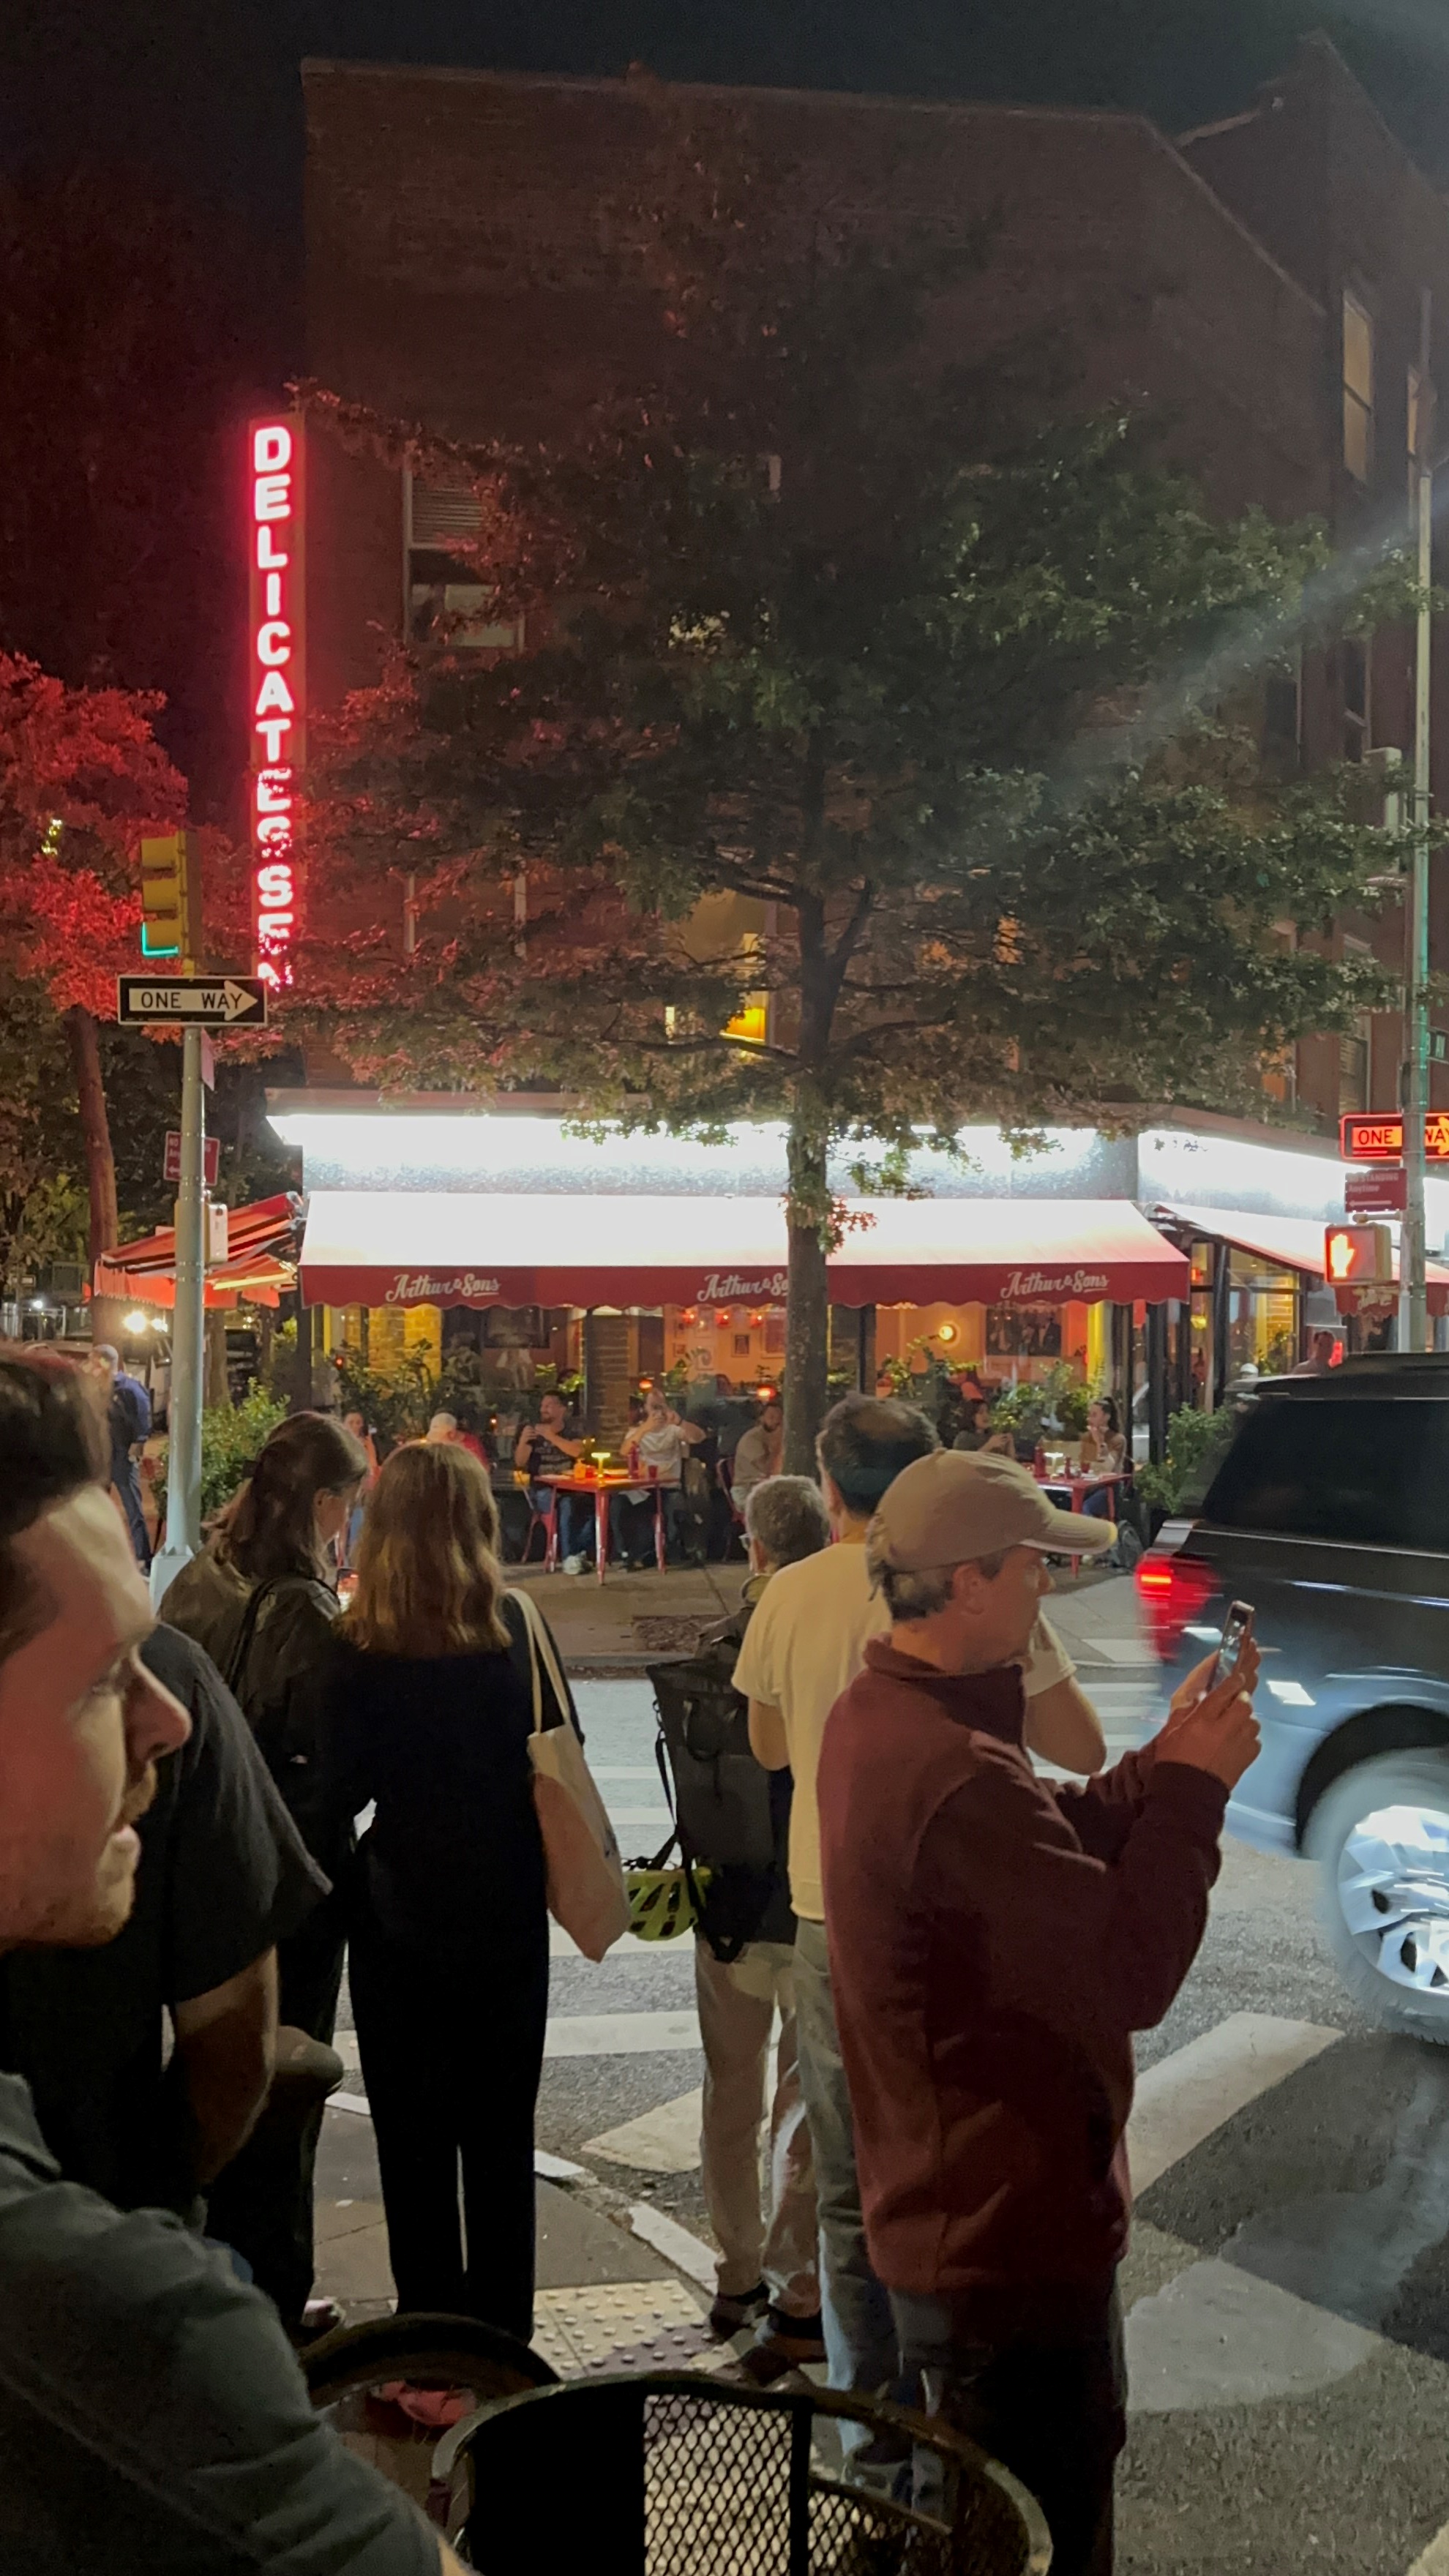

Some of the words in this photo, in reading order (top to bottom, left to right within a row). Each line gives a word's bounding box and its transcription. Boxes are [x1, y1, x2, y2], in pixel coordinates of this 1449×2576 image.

[141, 992, 181, 1009] ONE
[201, 992, 243, 1010] WAY
[1358, 1128, 1393, 1145] ONE
[385, 1273, 454, 1303] Arthur
[461, 1273, 501, 1298] Sons
[697, 1273, 763, 1302] Arthur
[771, 1273, 788, 1297] So
[1000, 1270, 1065, 1299] Arthur
[1072, 1270, 1109, 1293] Sons
